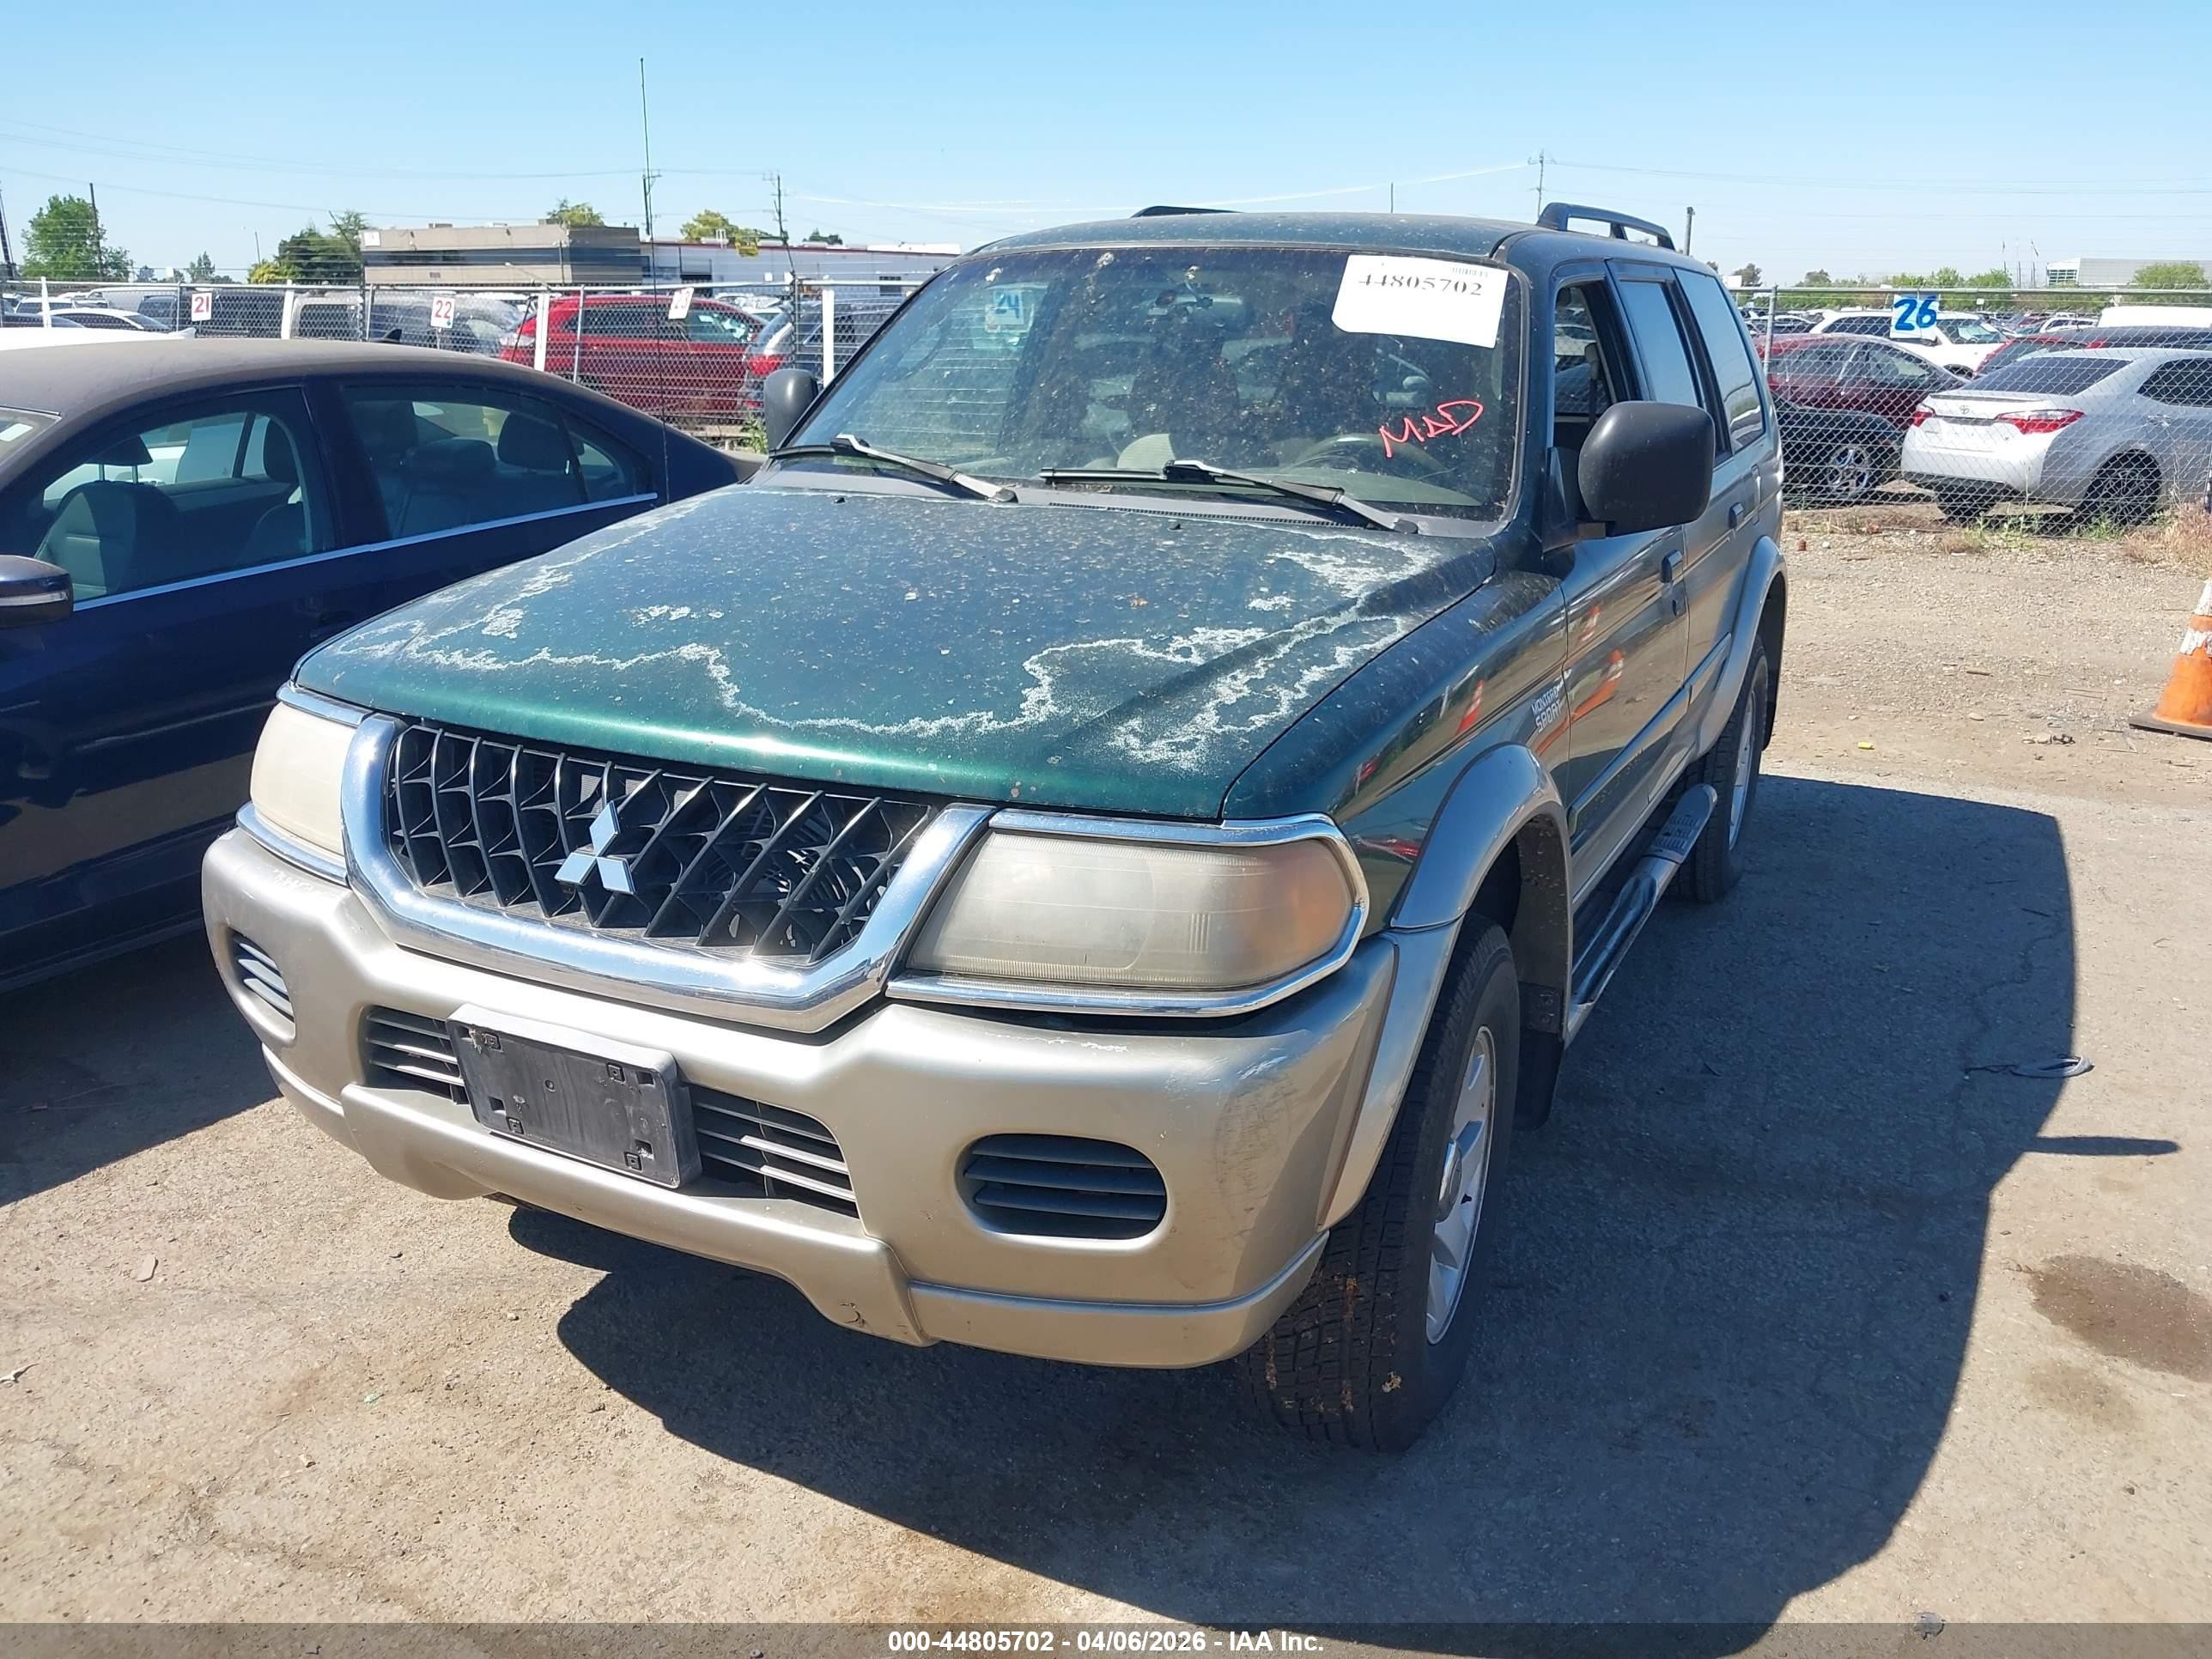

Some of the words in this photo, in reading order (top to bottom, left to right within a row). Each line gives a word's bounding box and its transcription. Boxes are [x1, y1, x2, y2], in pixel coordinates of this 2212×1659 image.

[1358, 274, 1482, 296] 44805702
[193, 295, 210, 313] 21
[434, 300, 453, 319] 22
[994, 291, 1020, 319] 24
[1893, 295, 1937, 331] 26
[1534, 699, 1563, 734] SPORT
